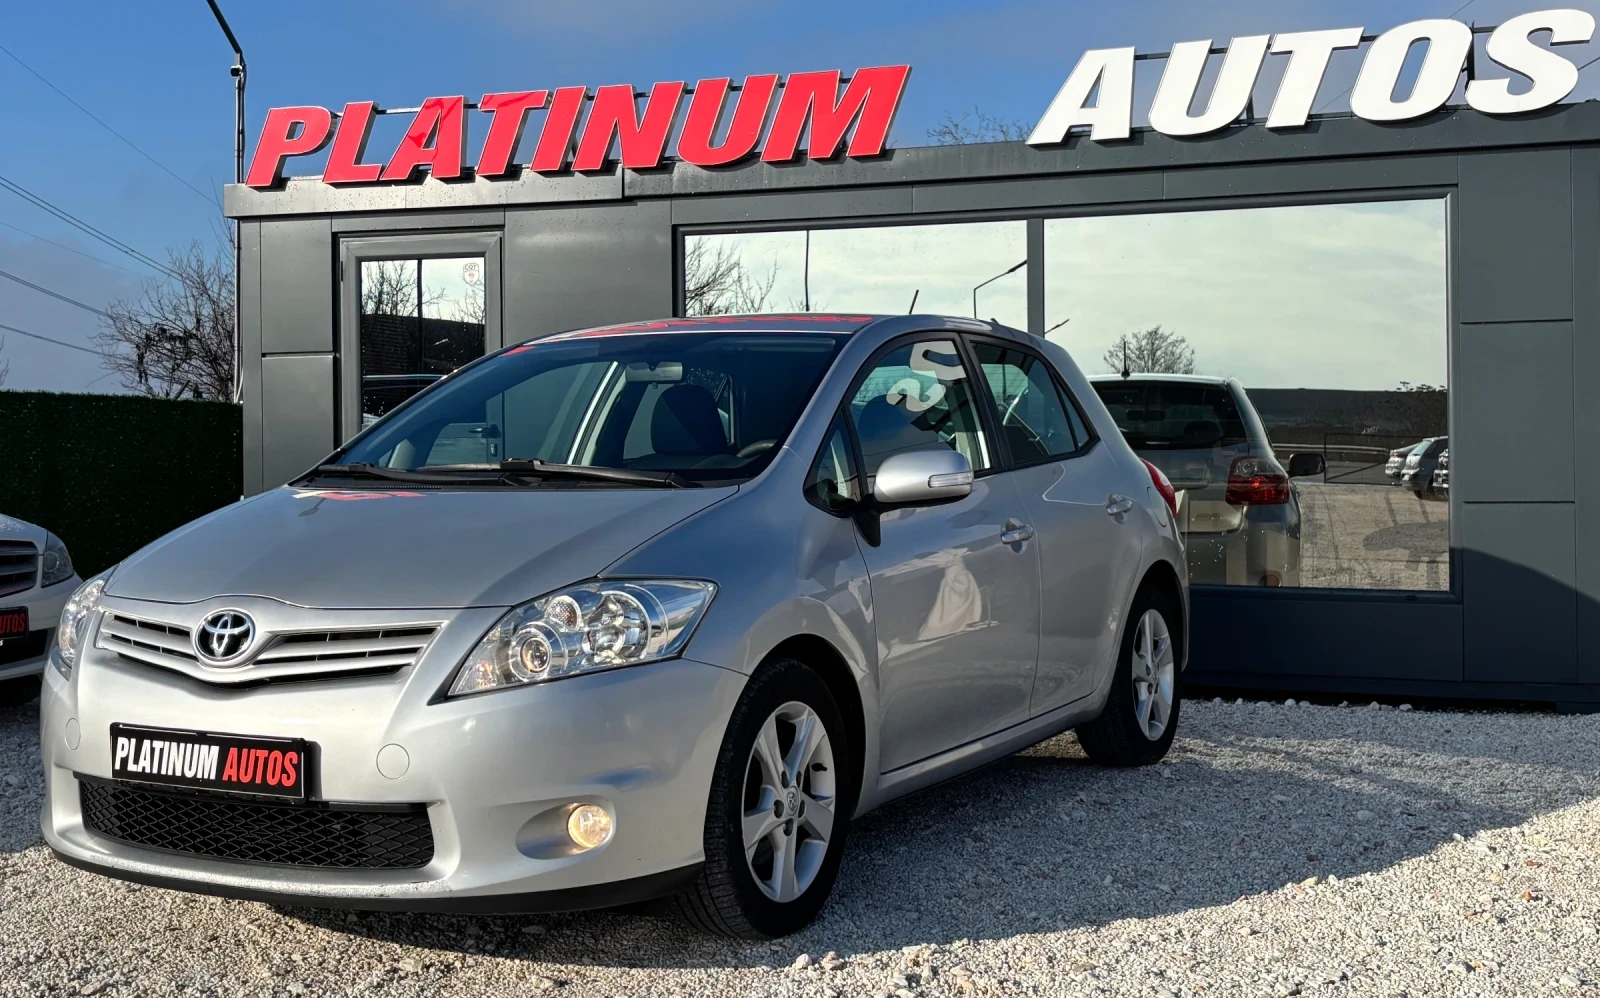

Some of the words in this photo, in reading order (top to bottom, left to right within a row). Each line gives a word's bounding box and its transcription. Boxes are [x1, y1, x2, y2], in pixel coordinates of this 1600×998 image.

[245, 64, 910, 187] PLATINUM
[1025, 8, 1596, 147] AUTOS
[114, 736, 220, 780] PLATINUM
[222, 747, 298, 787] AUTOS
